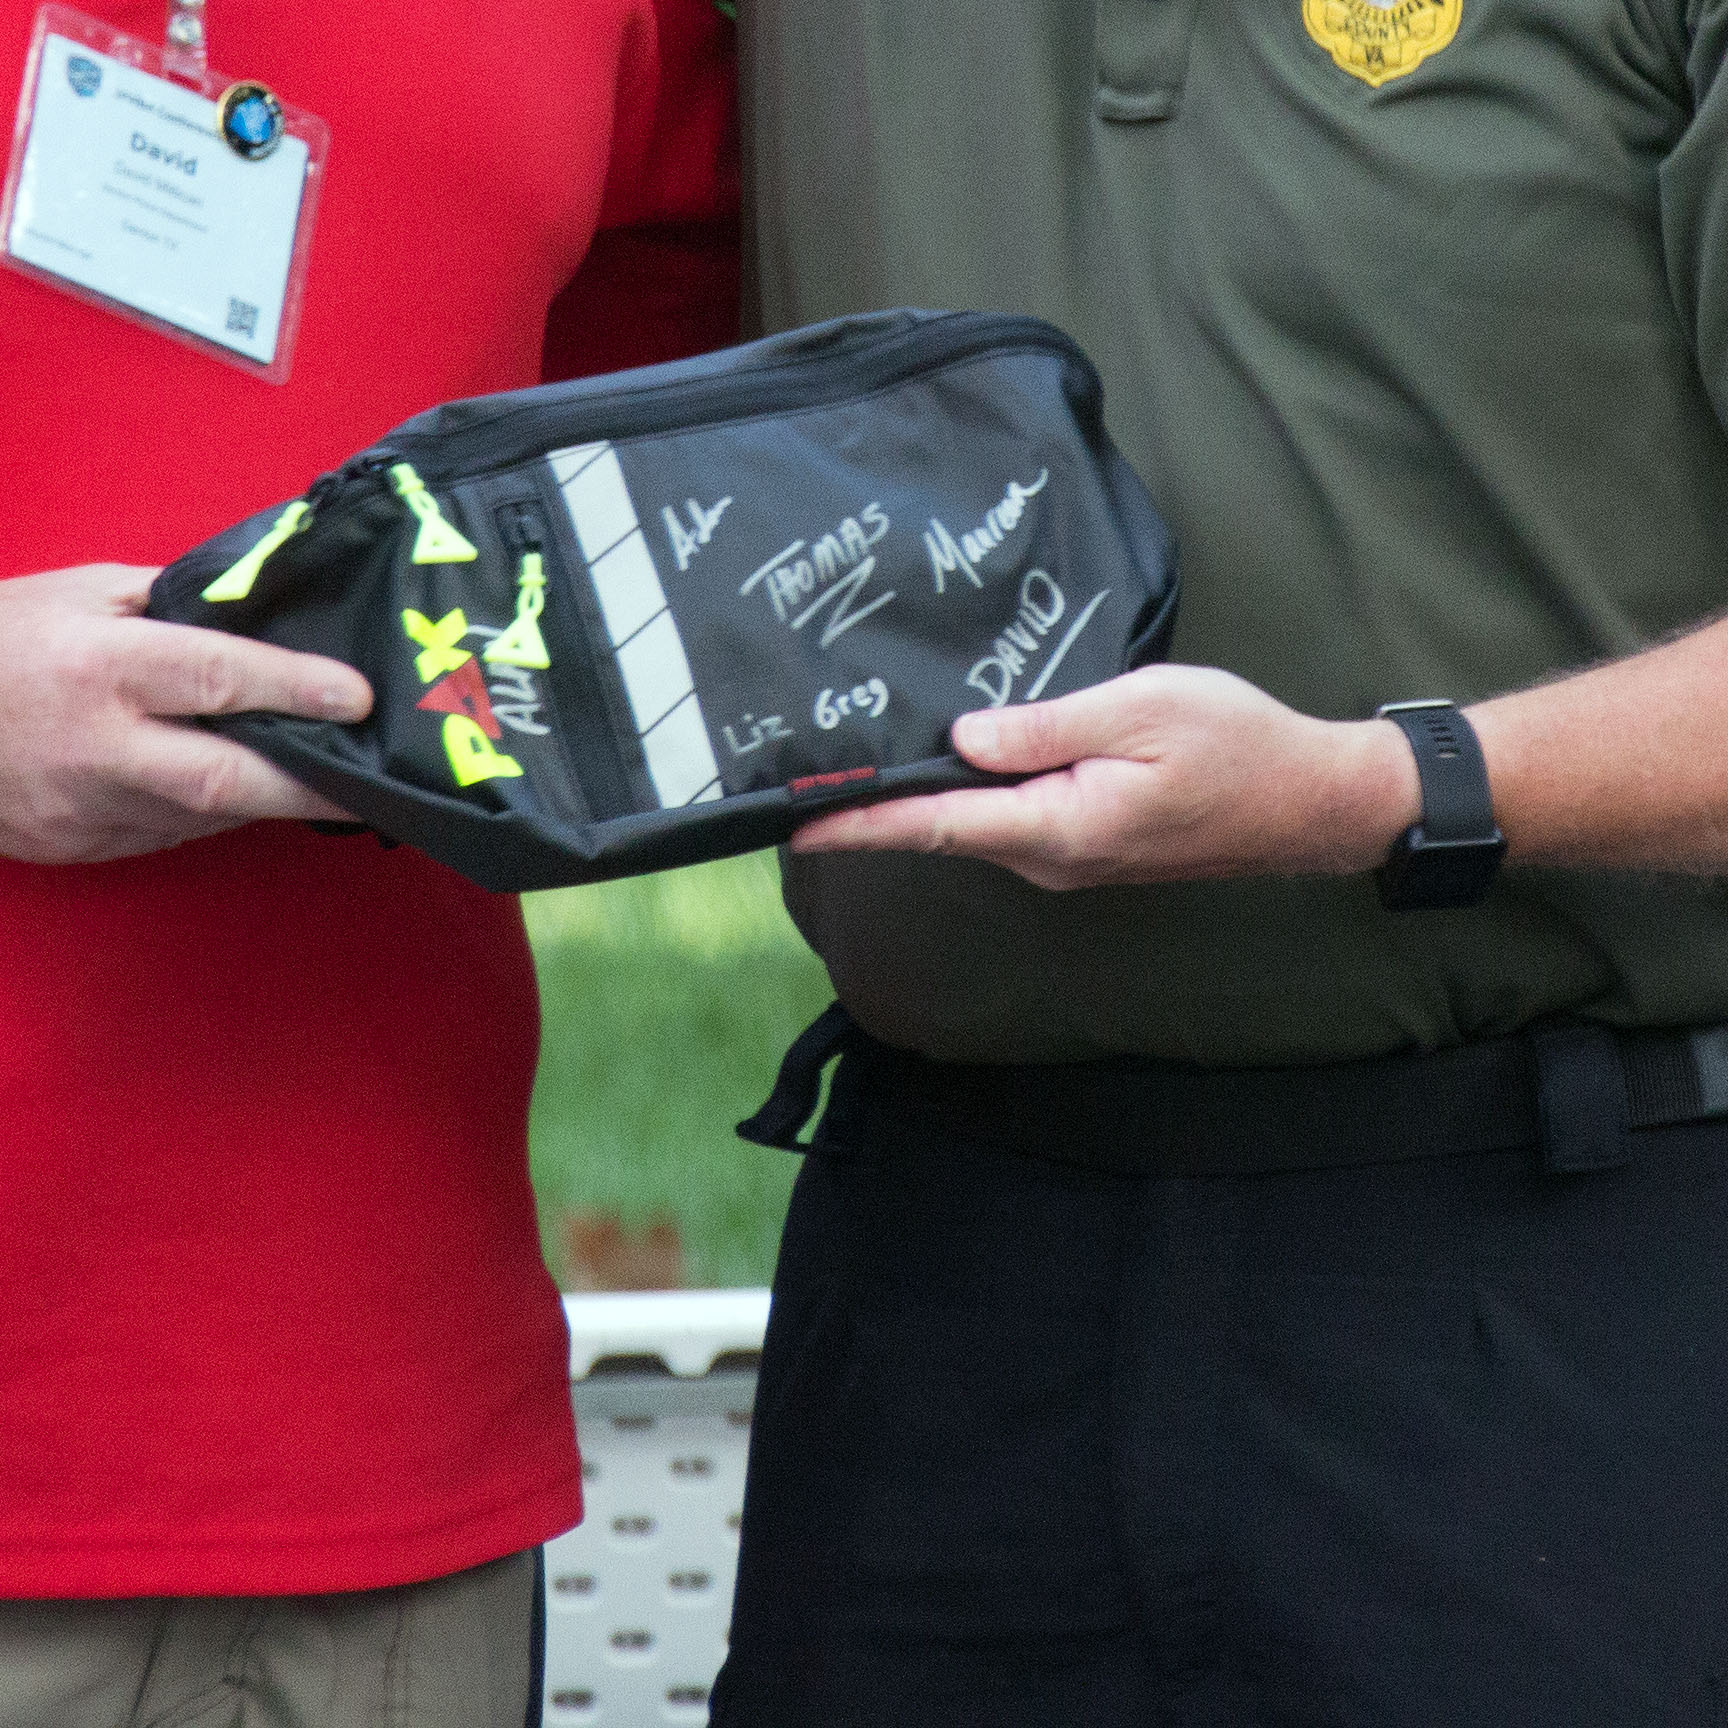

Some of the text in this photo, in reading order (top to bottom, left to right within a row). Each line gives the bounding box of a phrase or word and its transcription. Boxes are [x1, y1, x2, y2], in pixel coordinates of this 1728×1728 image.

[129, 129, 199, 177] David
[401, 607, 524, 788] PAX
[966, 567, 1066, 709] DAVID
